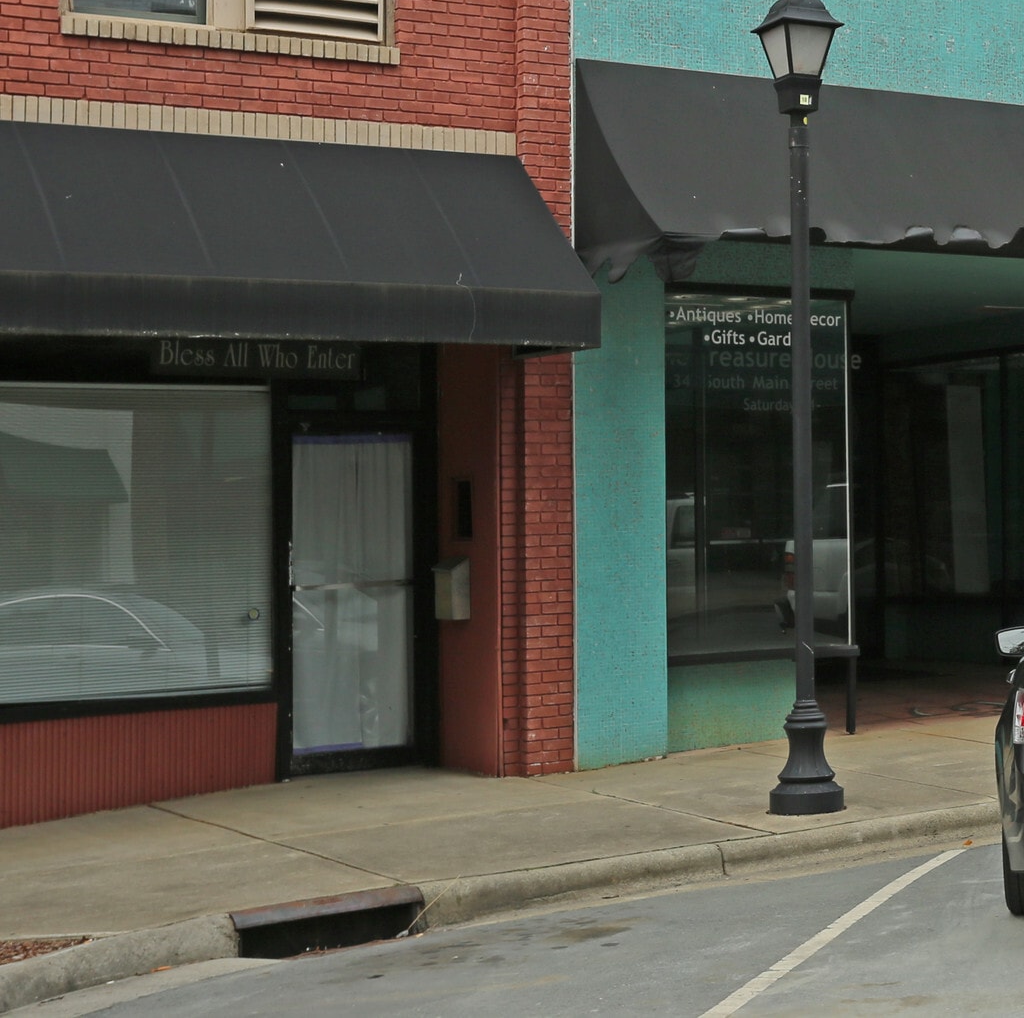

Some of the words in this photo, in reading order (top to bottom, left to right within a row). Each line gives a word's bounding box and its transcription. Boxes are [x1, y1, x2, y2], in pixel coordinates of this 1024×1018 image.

[809, 314, 842, 326] ecor
[711, 329, 746, 346] Gifts
[756, 332, 792, 347] Gard
[158, 340, 215, 367] Bless
[223, 342, 248, 368] All
[258, 343, 299, 369] Who
[306, 344, 355, 370] Enter
[708, 349, 793, 369] reasure
[811, 348, 863, 371] ouse
[752, 375, 789, 391] Main
